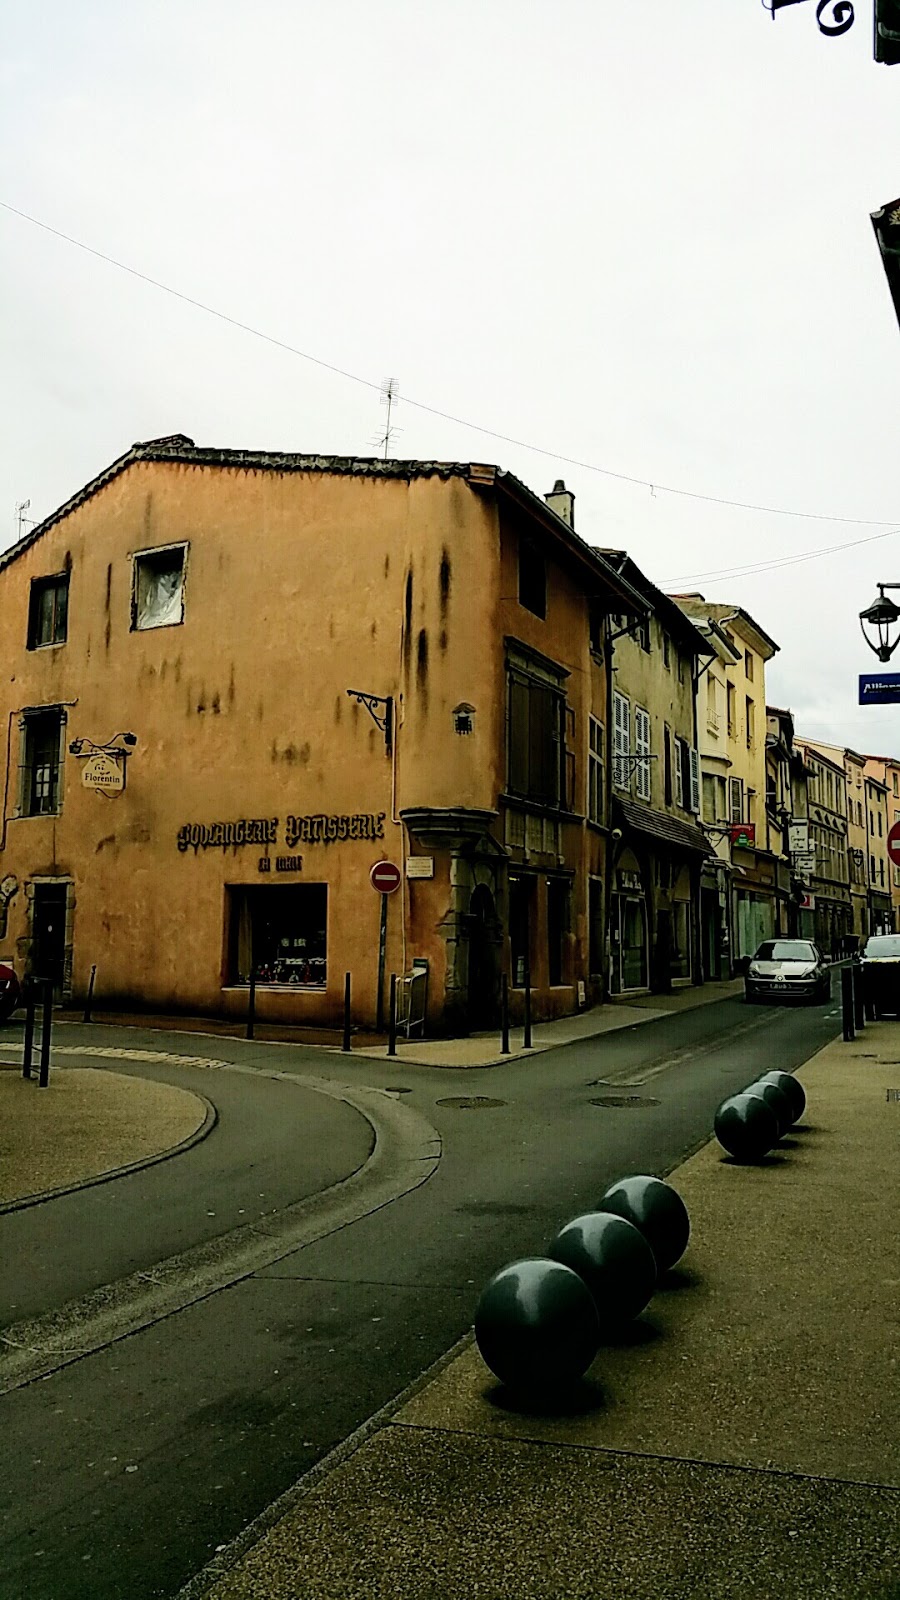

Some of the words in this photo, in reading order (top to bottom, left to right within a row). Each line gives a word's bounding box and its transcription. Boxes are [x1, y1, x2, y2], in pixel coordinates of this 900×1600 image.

[85, 773, 120, 783] Florentin
[178, 818, 279, 851] BOULANGERIE
[286, 812, 386, 847] PATISSERIE
